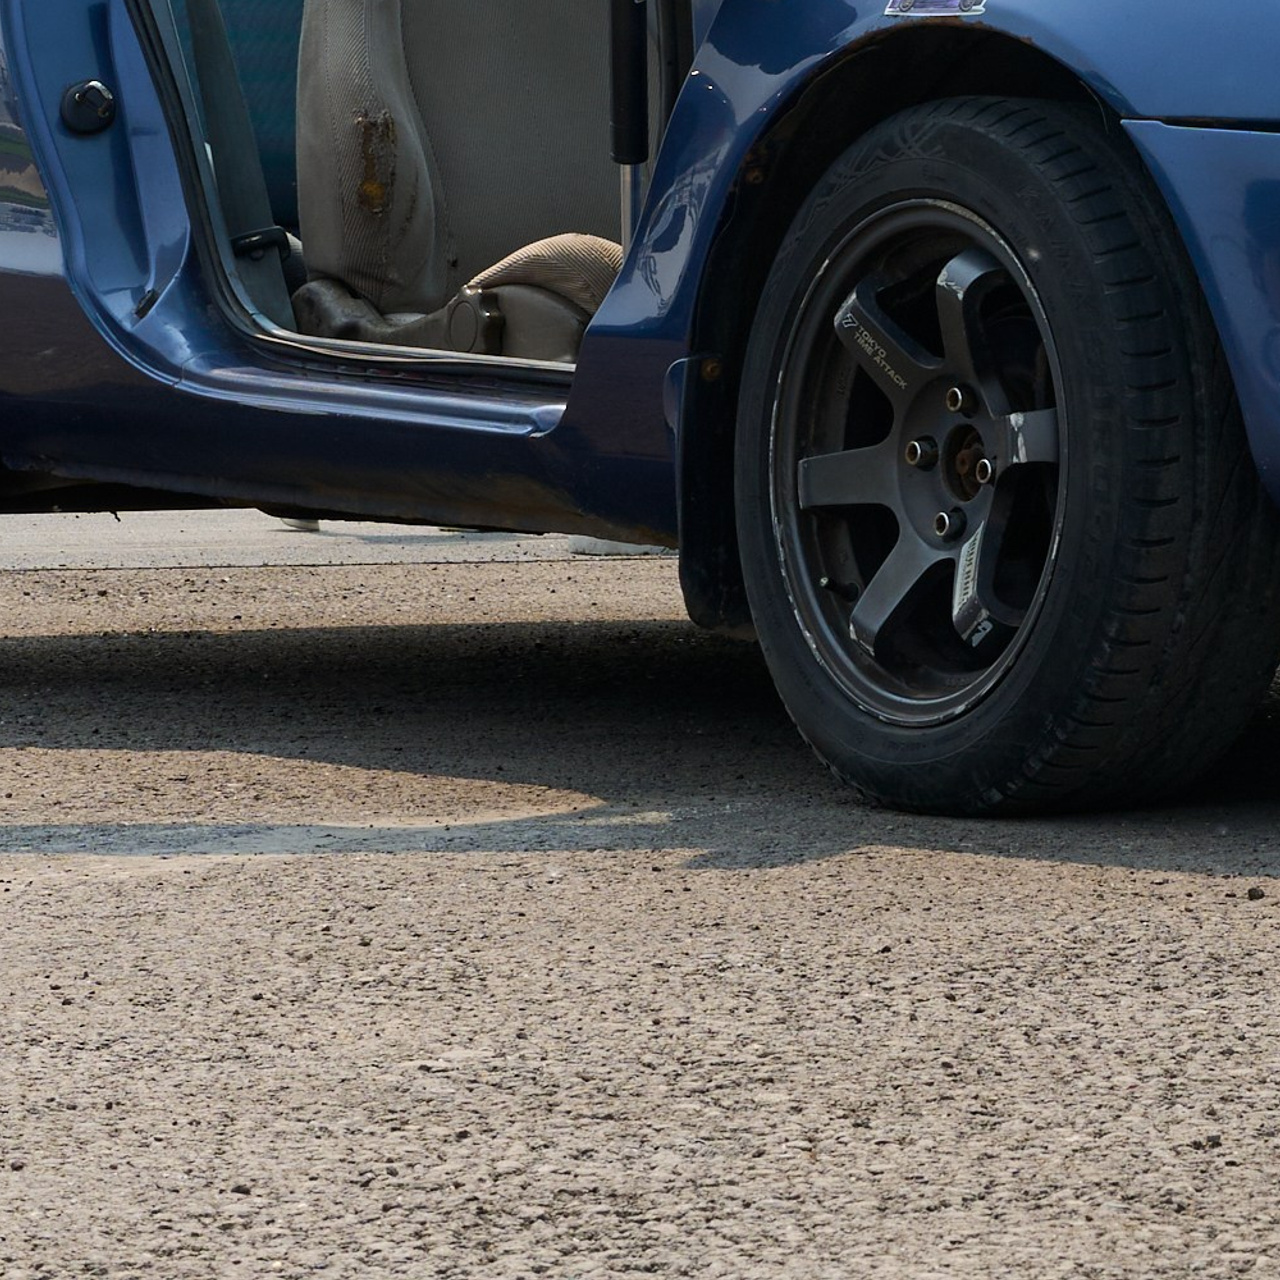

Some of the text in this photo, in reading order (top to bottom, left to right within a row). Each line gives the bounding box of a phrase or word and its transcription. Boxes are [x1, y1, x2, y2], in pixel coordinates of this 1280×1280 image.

[854, 332, 907, 390] TIME ATTACK
[859, 325, 886, 358] TOKYO
